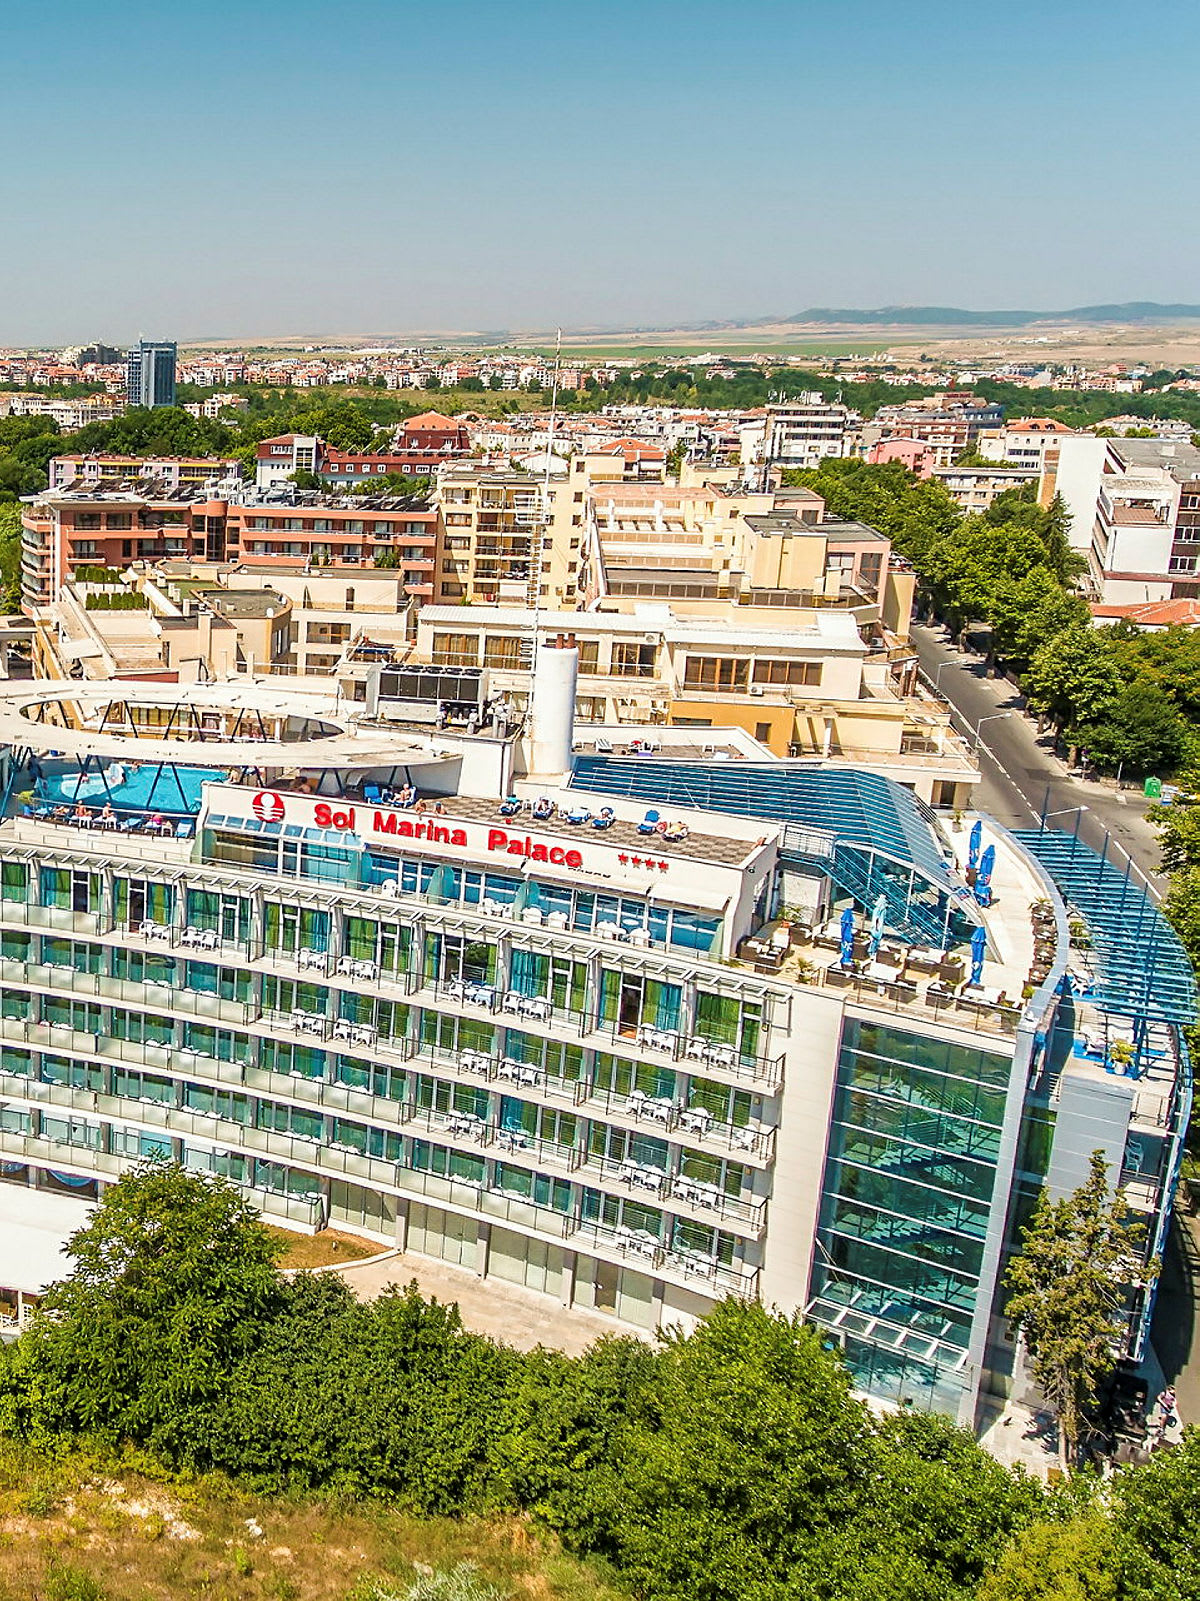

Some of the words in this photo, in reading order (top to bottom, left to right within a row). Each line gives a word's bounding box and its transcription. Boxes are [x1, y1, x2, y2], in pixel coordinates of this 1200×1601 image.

[313, 803, 356, 832] Sol
[372, 810, 468, 847] Marina
[487, 829, 583, 869] Palace
